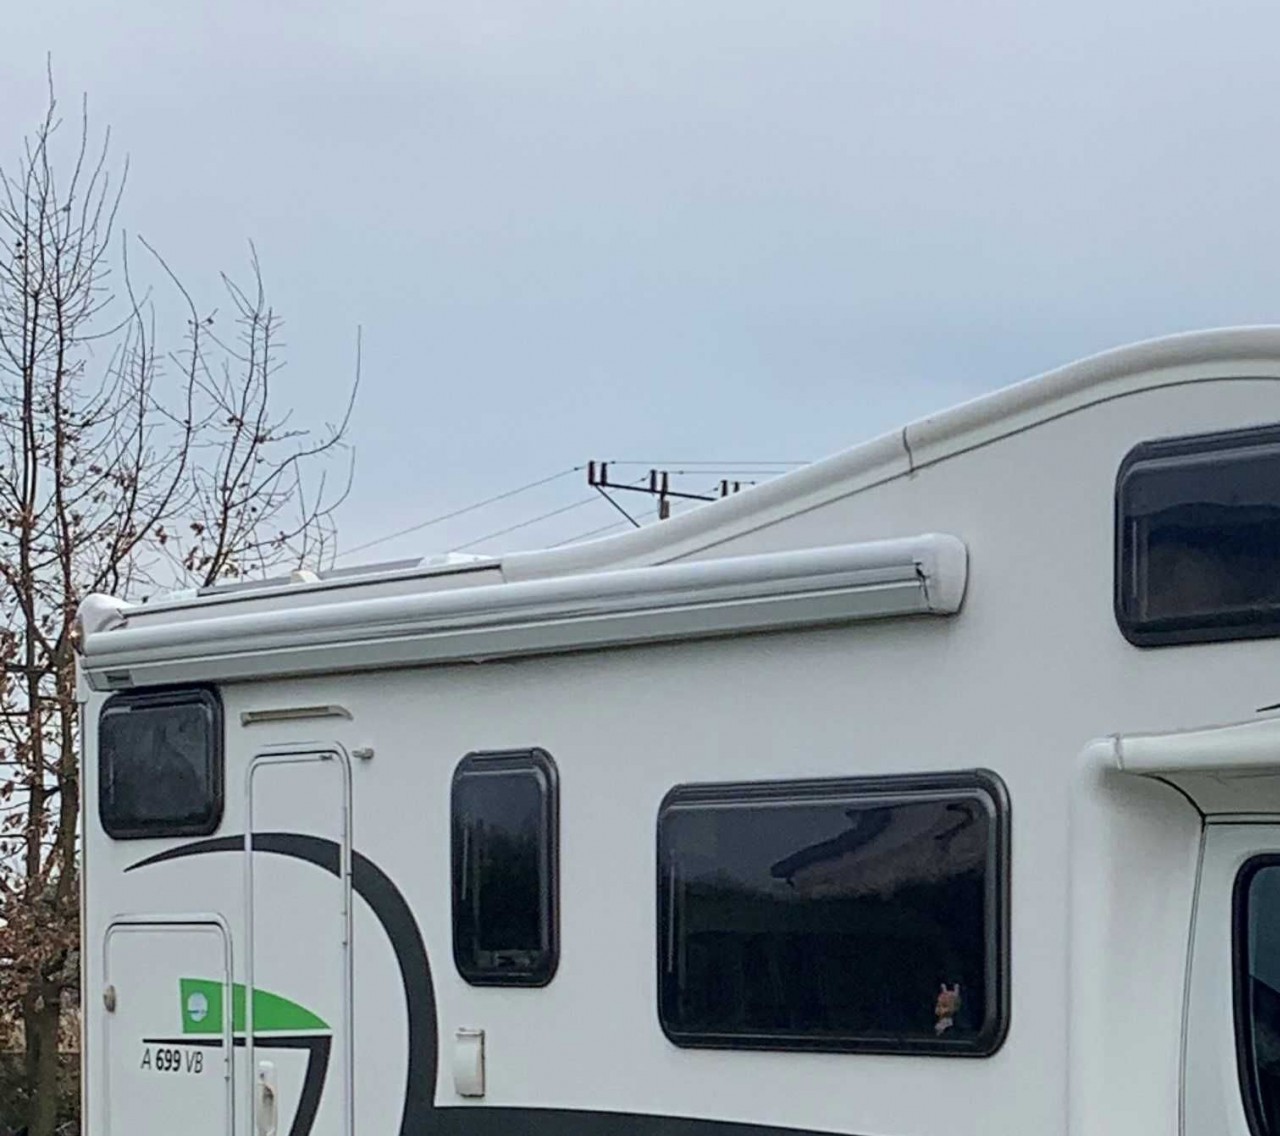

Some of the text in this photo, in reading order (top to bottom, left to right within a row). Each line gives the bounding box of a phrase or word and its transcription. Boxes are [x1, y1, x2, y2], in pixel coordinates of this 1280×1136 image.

[141, 1048, 203, 1074] A 699 VB
